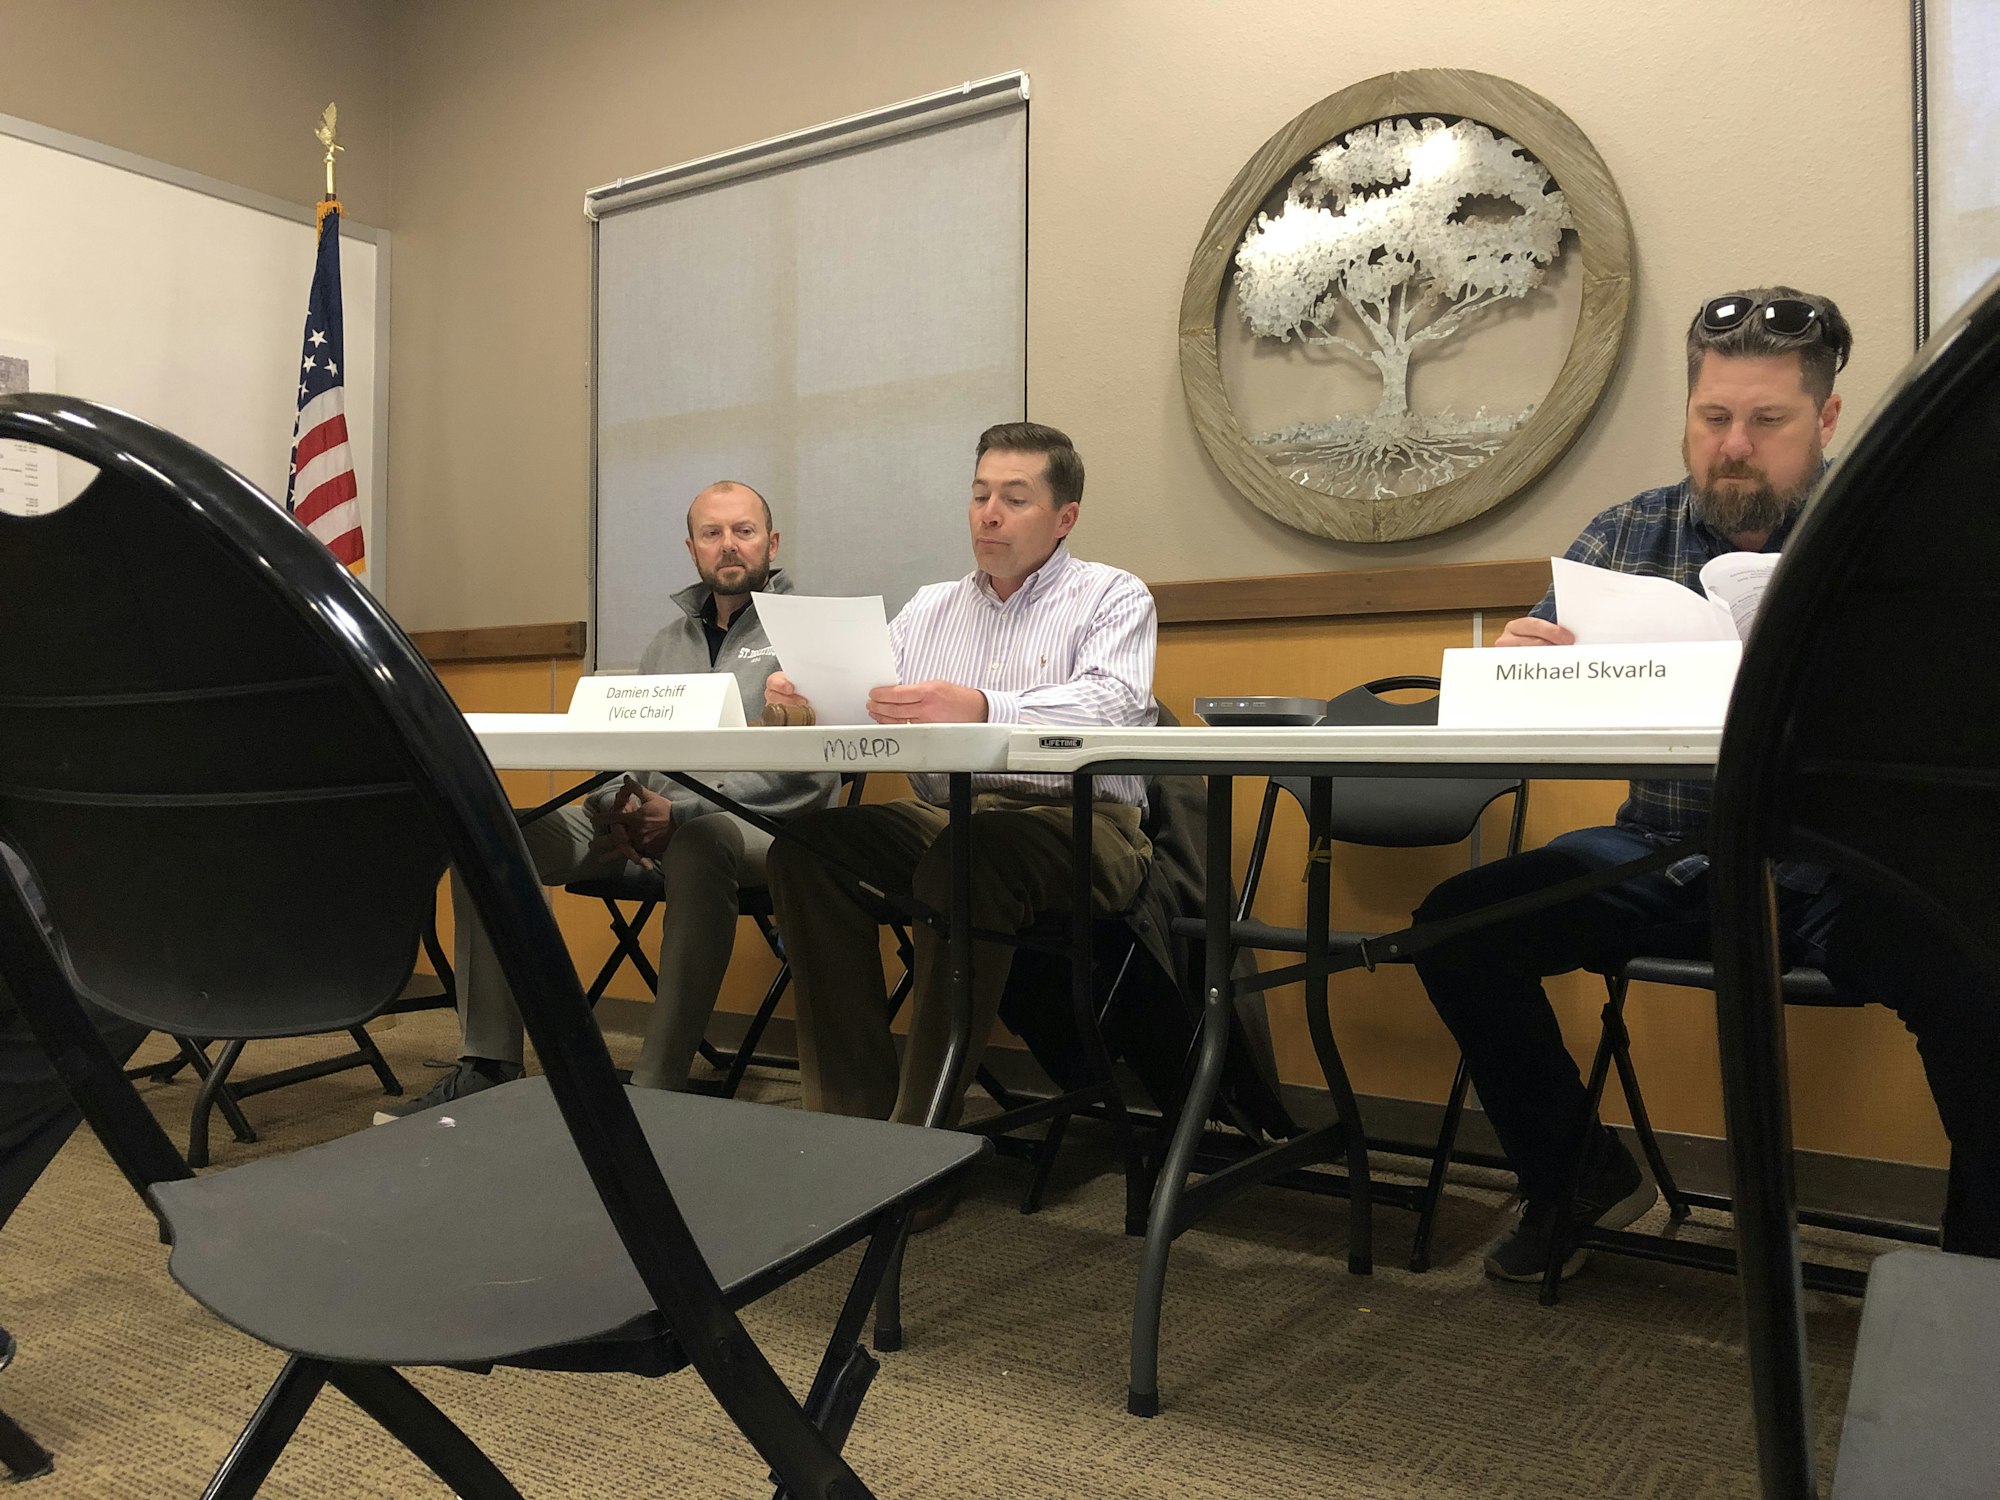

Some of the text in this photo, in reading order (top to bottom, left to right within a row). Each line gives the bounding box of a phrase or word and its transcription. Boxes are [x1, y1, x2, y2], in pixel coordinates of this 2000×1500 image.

[1496, 660, 1666, 681] Mikhael Skvarla
[606, 684, 686, 699] Damien Schiff
[608, 705, 674, 721] (Vice Chair)
[823, 737, 900, 763] MORPD
[1044, 739, 1078, 747] LIFETIME
